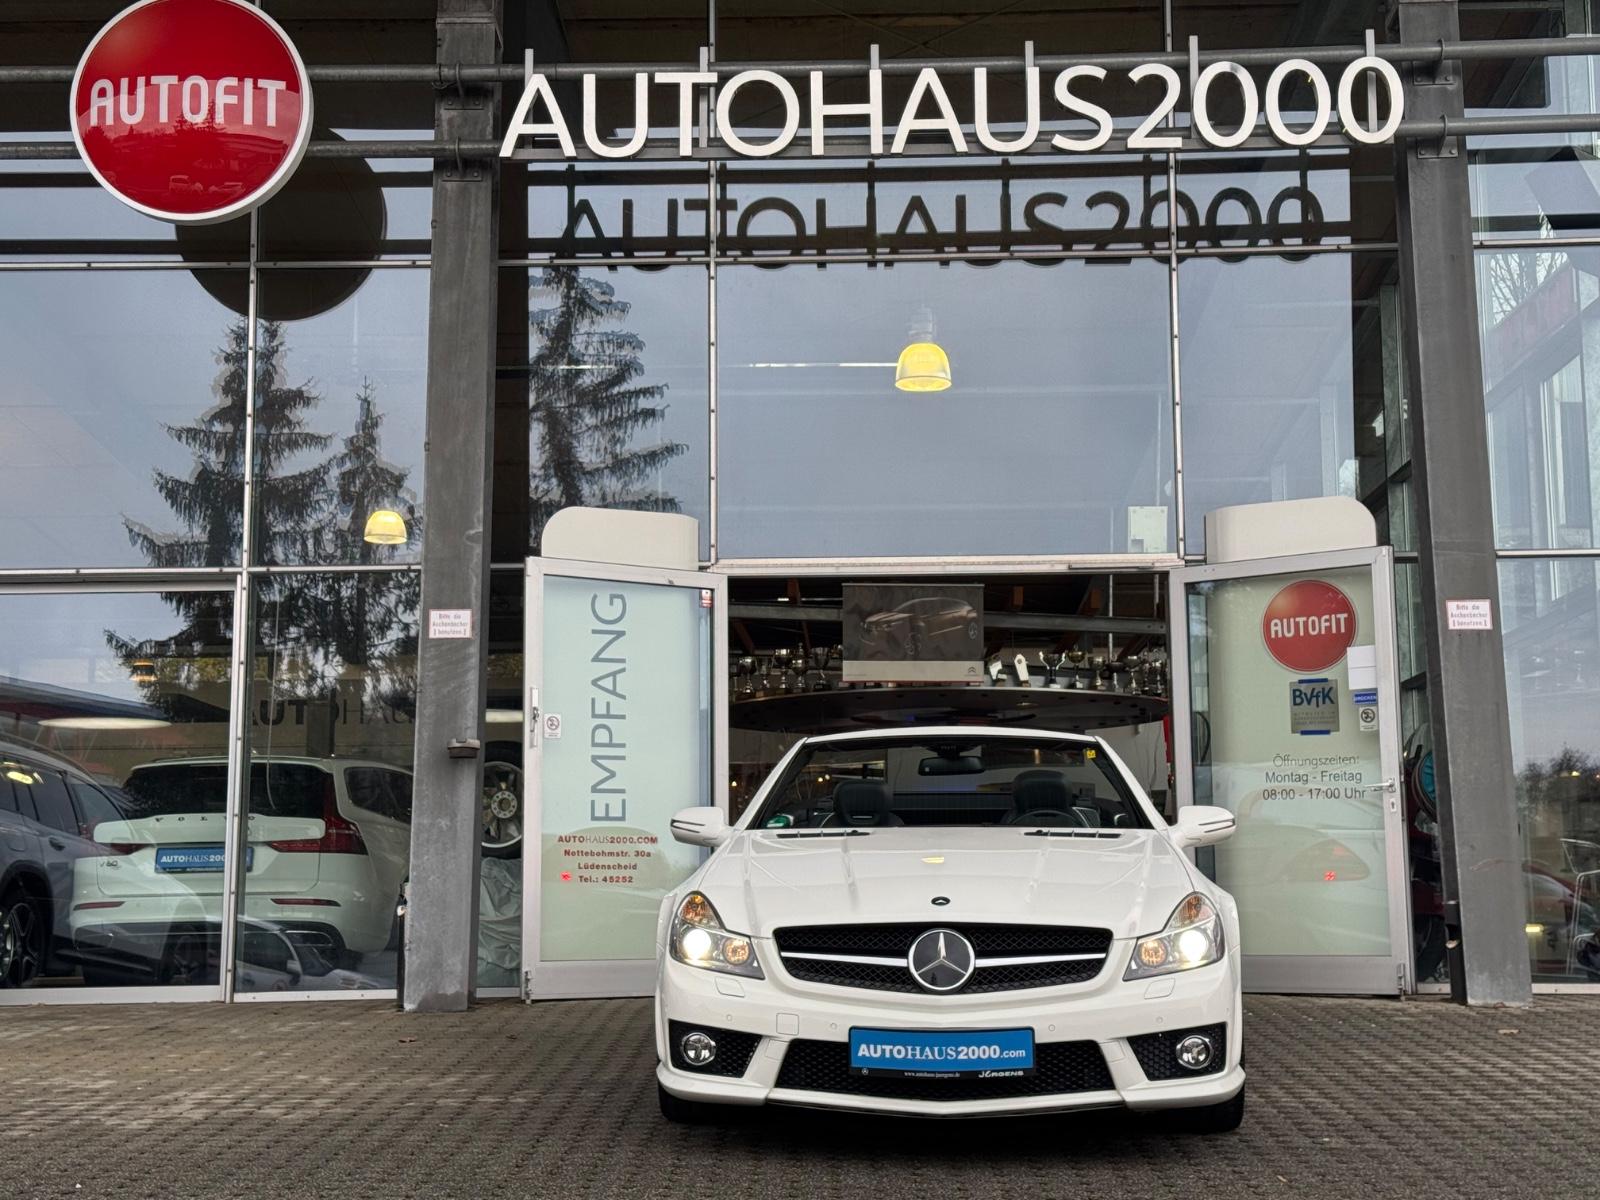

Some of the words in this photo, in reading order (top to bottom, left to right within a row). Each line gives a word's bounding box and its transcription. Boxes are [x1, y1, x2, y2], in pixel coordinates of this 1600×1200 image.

[90, 75, 286, 127] AUTOFIT
[499, 56, 1404, 158] AUTOHAUS2000
[1270, 613, 1349, 639] AUTOFIT
[590, 592, 627, 822] EMPFANG
[1272, 753, 1360, 769] Öffnungszeiten:
[1265, 771, 1309, 785] Montag
[1320, 770, 1363, 784] Freitag
[1262, 788, 1296, 801] 08:00
[1308, 787, 1341, 800] 17:00
[1344, 787, 1367, 800] Uhr
[557, 835, 659, 844] AUTOHAUS2000.COM
[564, 849, 631, 858] Nottebohmstr.
[634, 850, 652, 858] 30a
[577, 862, 638, 870] Lüdenscheid
[857, 1043, 1026, 1060] AUTOHAUS2000.com
